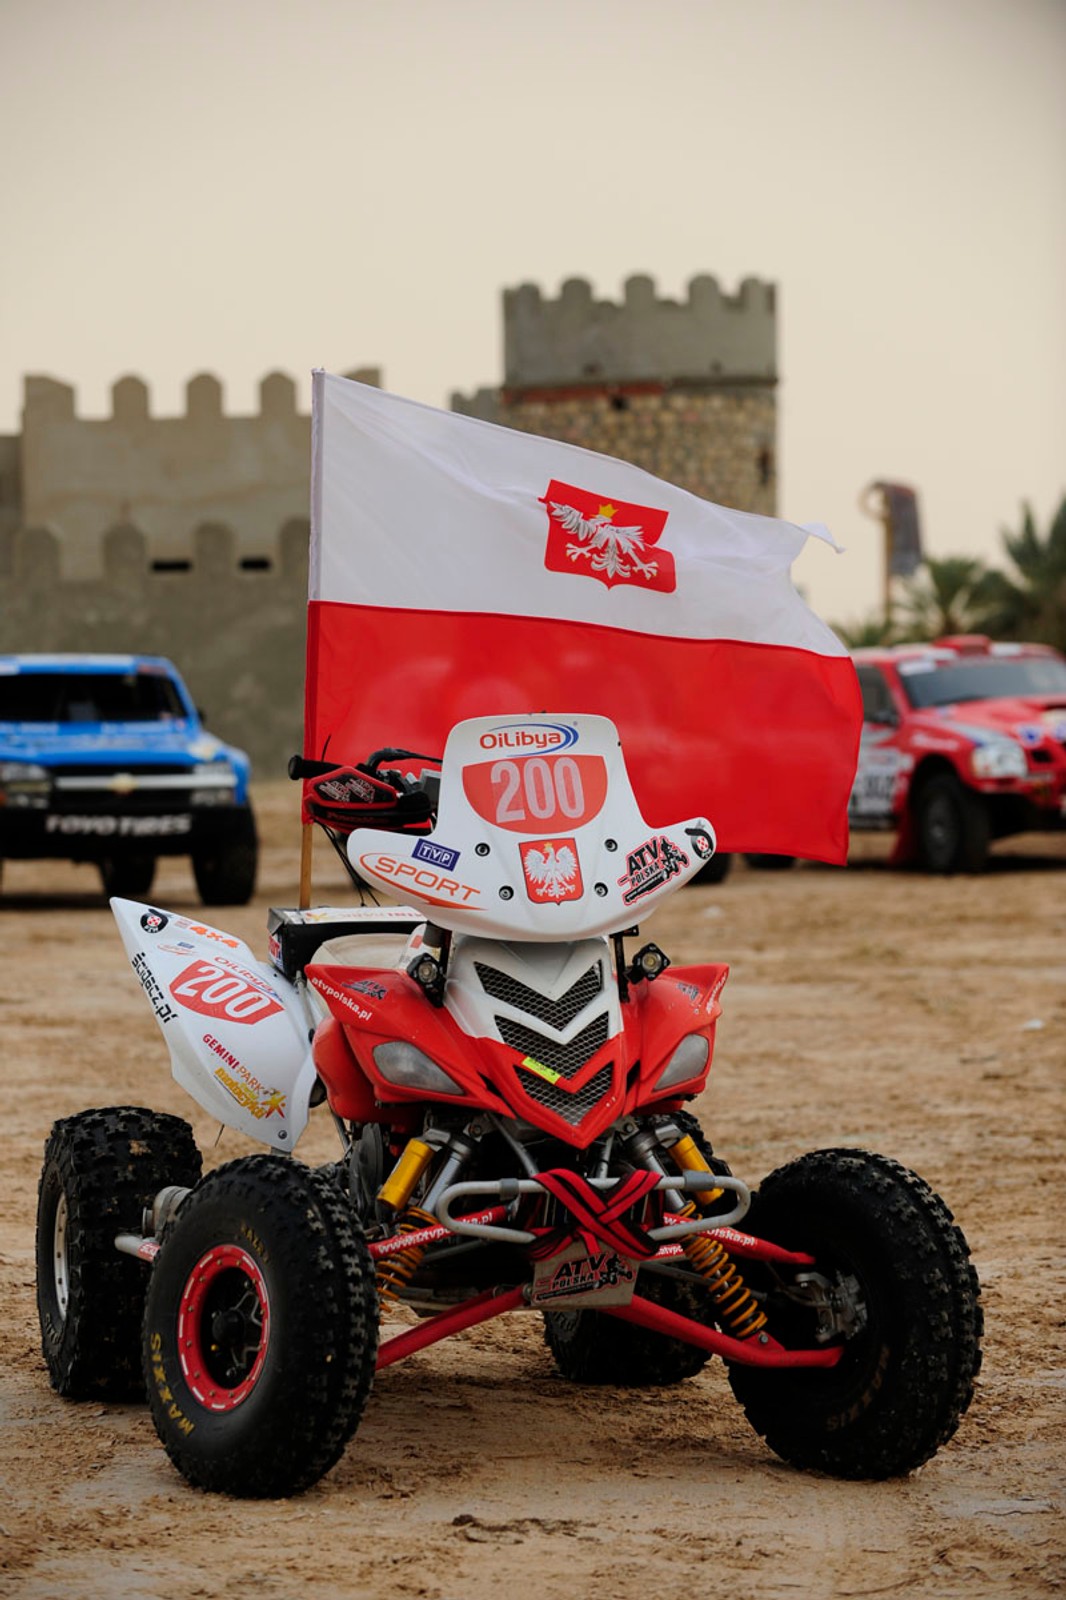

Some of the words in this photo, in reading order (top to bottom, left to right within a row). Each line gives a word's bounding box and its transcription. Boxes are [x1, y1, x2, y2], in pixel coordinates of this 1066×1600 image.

[479, 731, 562, 749] OiLibya
[490, 757, 585, 824] 200
[419, 844, 453, 865] TVP
[627, 839, 659, 876] ATV
[631, 862, 660, 886] POLSKA
[374, 856, 481, 901] SPORT
[173, 965, 272, 1019] 200
[311, 976, 373, 1021] atvpolska.pl
[202, 1033, 240, 1070] GEMINI
[235, 1065, 265, 1093] PARK
[554, 1253, 606, 1281] ATV
[150, 1332, 195, 1436] MAXXIS
